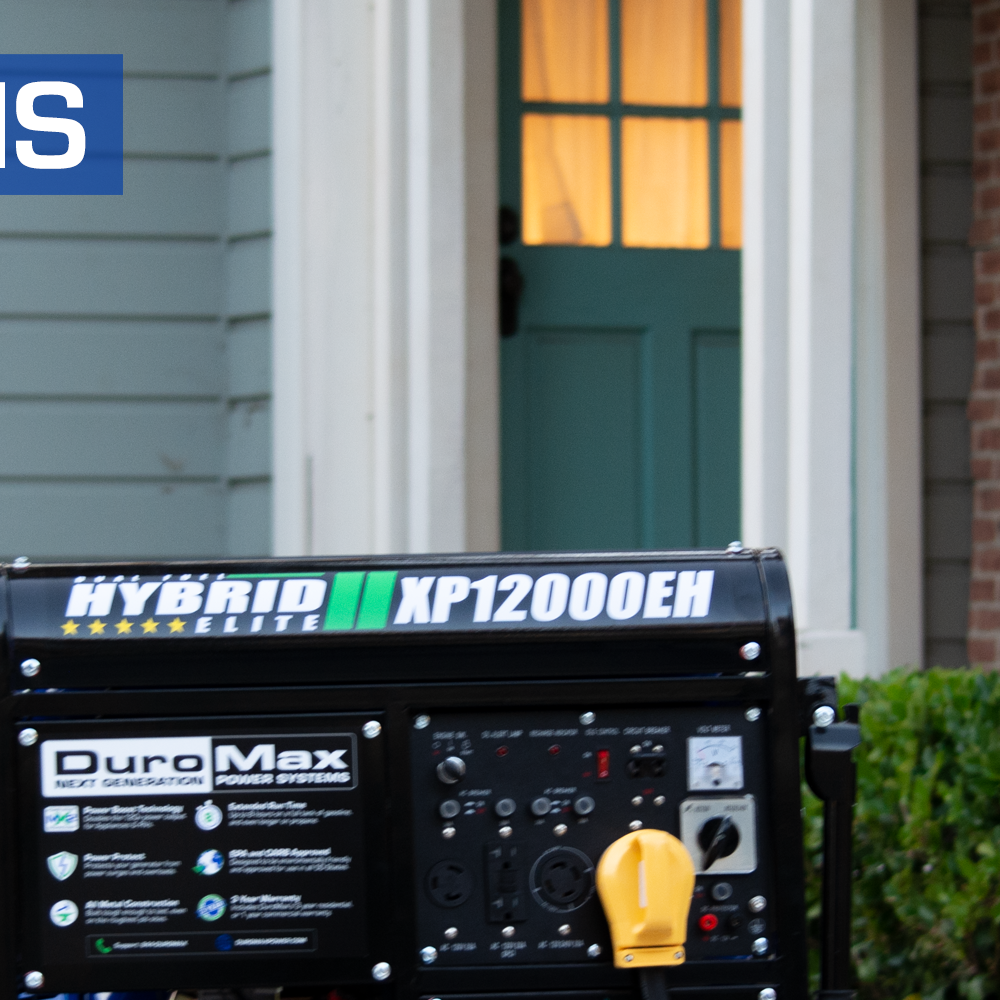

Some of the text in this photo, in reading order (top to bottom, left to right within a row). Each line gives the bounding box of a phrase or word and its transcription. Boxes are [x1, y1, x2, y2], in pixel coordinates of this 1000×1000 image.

[65, 570, 715, 626] HYBRID XP12000EH
[194, 614, 321, 633] ELITE
[54, 771, 351, 789] NEXT GENERATION POWER SYSTEMS
